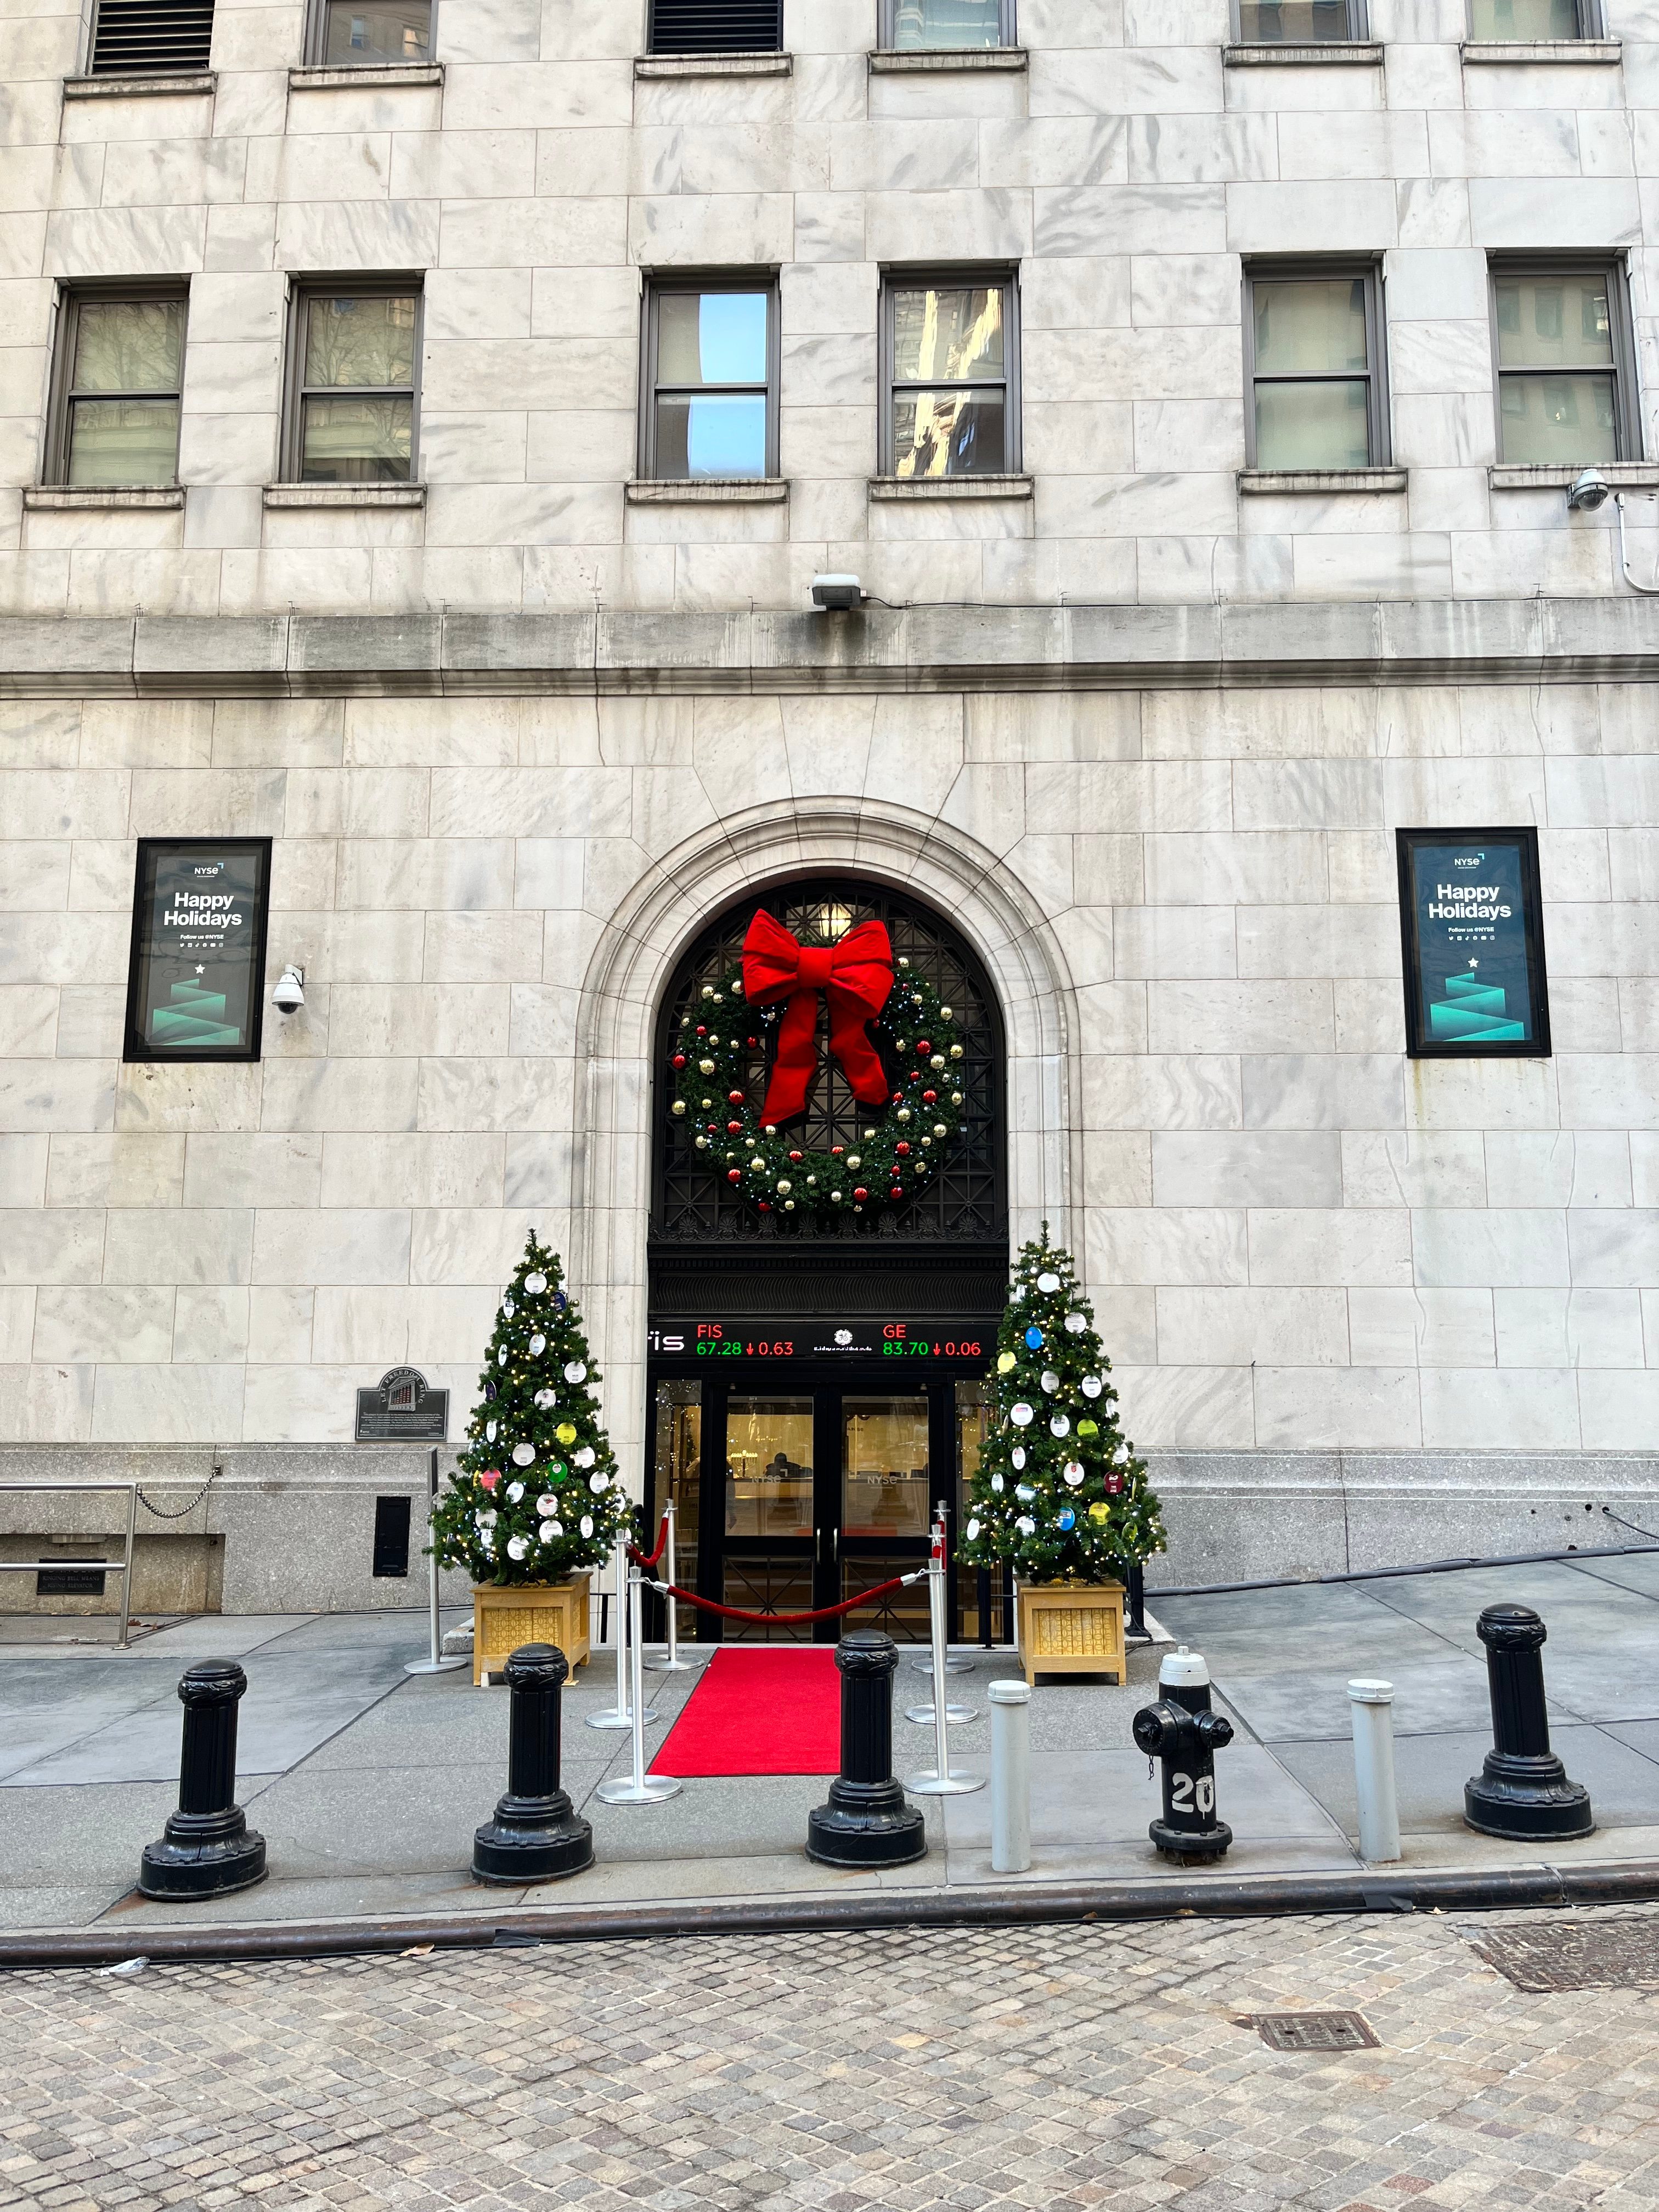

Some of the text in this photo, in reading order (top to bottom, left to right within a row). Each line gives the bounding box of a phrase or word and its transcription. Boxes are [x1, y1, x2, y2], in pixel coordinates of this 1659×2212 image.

[174, 892, 234, 910] Happy
[1437, 884, 1500, 902] Happy
[164, 910, 242, 929] Holidays
[1429, 903, 1511, 921] Holidays
[697, 1325, 722, 1338] FIS
[883, 1325, 906, 1338] GE
[697, 1342, 793, 1355] 67.28 0.63
[883, 1342, 981, 1355] 83.70 0.06
[1171, 1773, 1214, 1814] 20
